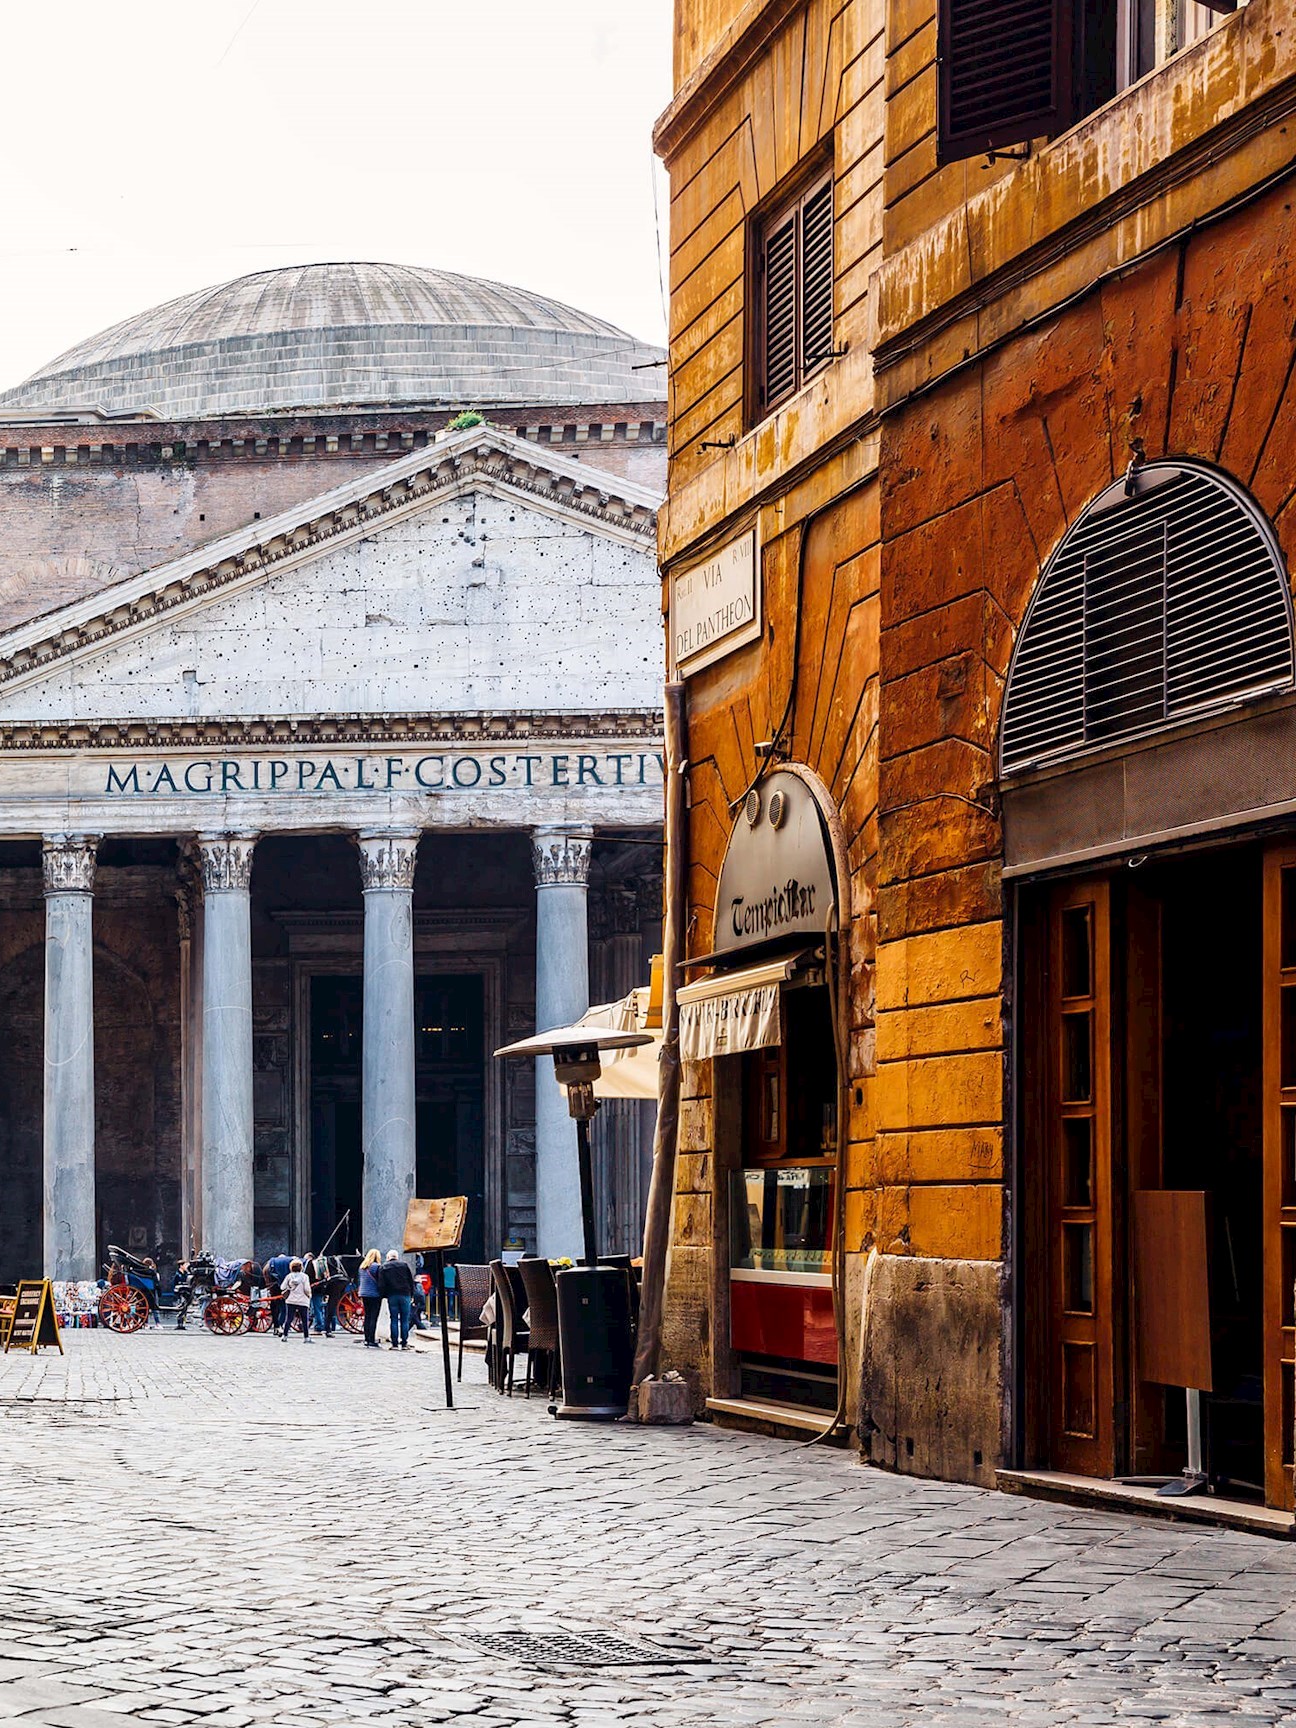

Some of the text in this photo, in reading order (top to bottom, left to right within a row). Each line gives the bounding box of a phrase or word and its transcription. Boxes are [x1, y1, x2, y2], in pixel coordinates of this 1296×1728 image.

[704, 563, 722, 589] VIA
[676, 594, 752, 657] DEL PANTHEON
